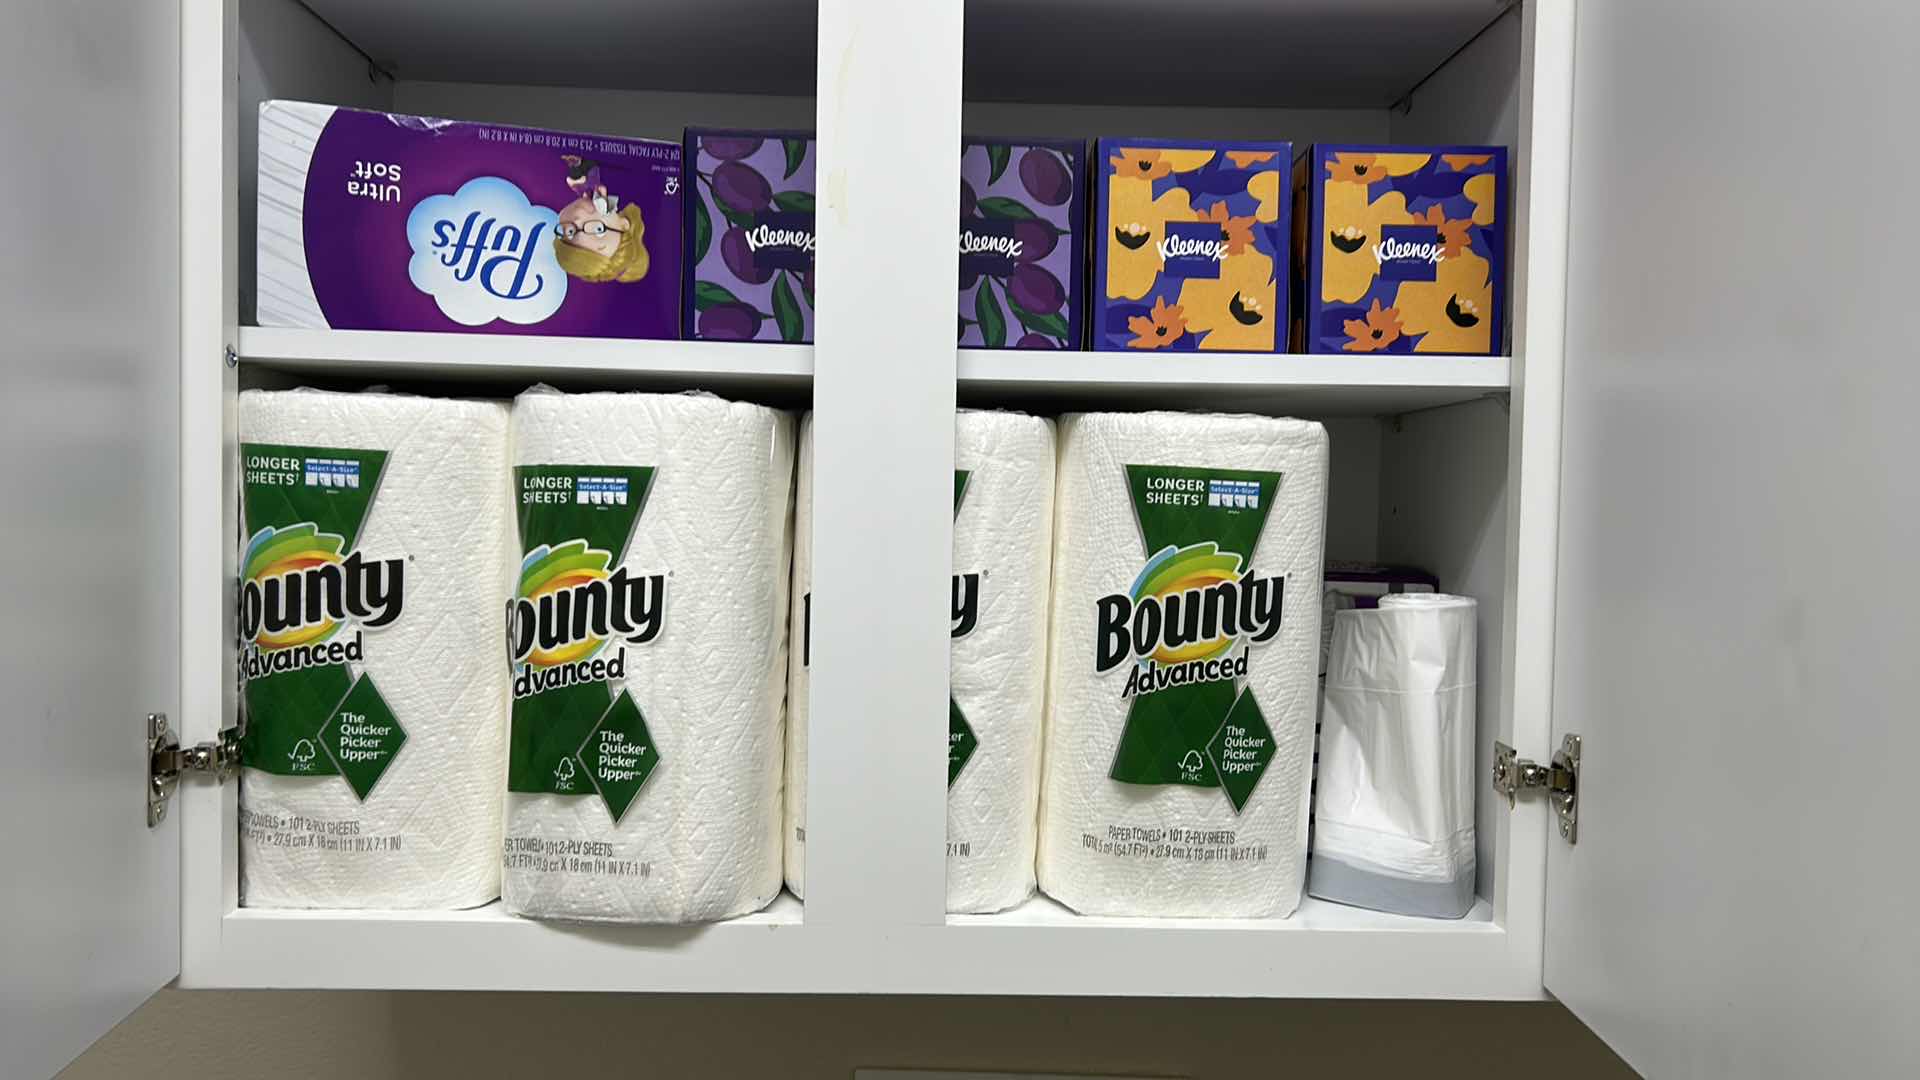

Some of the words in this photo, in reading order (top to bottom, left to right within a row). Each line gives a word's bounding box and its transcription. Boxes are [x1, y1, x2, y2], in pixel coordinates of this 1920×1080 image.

[600, 141, 626, 154] TISSUES
[355, 160, 402, 181] Soft
[347, 181, 401, 202] Ultra
[744, 224, 816, 252] Kleenex
[1156, 234, 1229, 262] Kleenex
[1372, 237, 1446, 265] Kleenex
[432, 211, 547, 300] Puffs
[246, 456, 300, 470] LONGER
[523, 477, 572, 489] LONGER
[1147, 478, 1205, 492] LONGER
[238, 551, 404, 640] ounty
[1096, 569, 1285, 672] Bounty
[514, 647, 625, 697] dvanced
[1122, 646, 1250, 698] Advanced
[340, 712, 366, 723] The
[340, 724, 392, 736] Quicker
[600, 730, 624, 742] The
[1226, 726, 1246, 736] The
[340, 736, 382, 748] Picker
[599, 742, 646, 756] Quicker
[1224, 736, 1266, 748] Quicker
[340, 748, 380, 762] Upper
[598, 754, 638, 768] Picker
[1223, 748, 1258, 760] Picker
[1222, 760, 1255, 774] Upper
[598, 768, 636, 782] Upper
[288, 816, 304, 830] 101
[327, 820, 360, 835] SHEETS
[1108, 825, 1132, 842] PAPER
[1132, 826, 1161, 842] TOWELS
[1169, 828, 1182, 842] 101
[1184, 830, 1207, 844] 2-PLY
[1208, 831, 1236, 845] SHEETS
[584, 842, 613, 858] SHEETS
